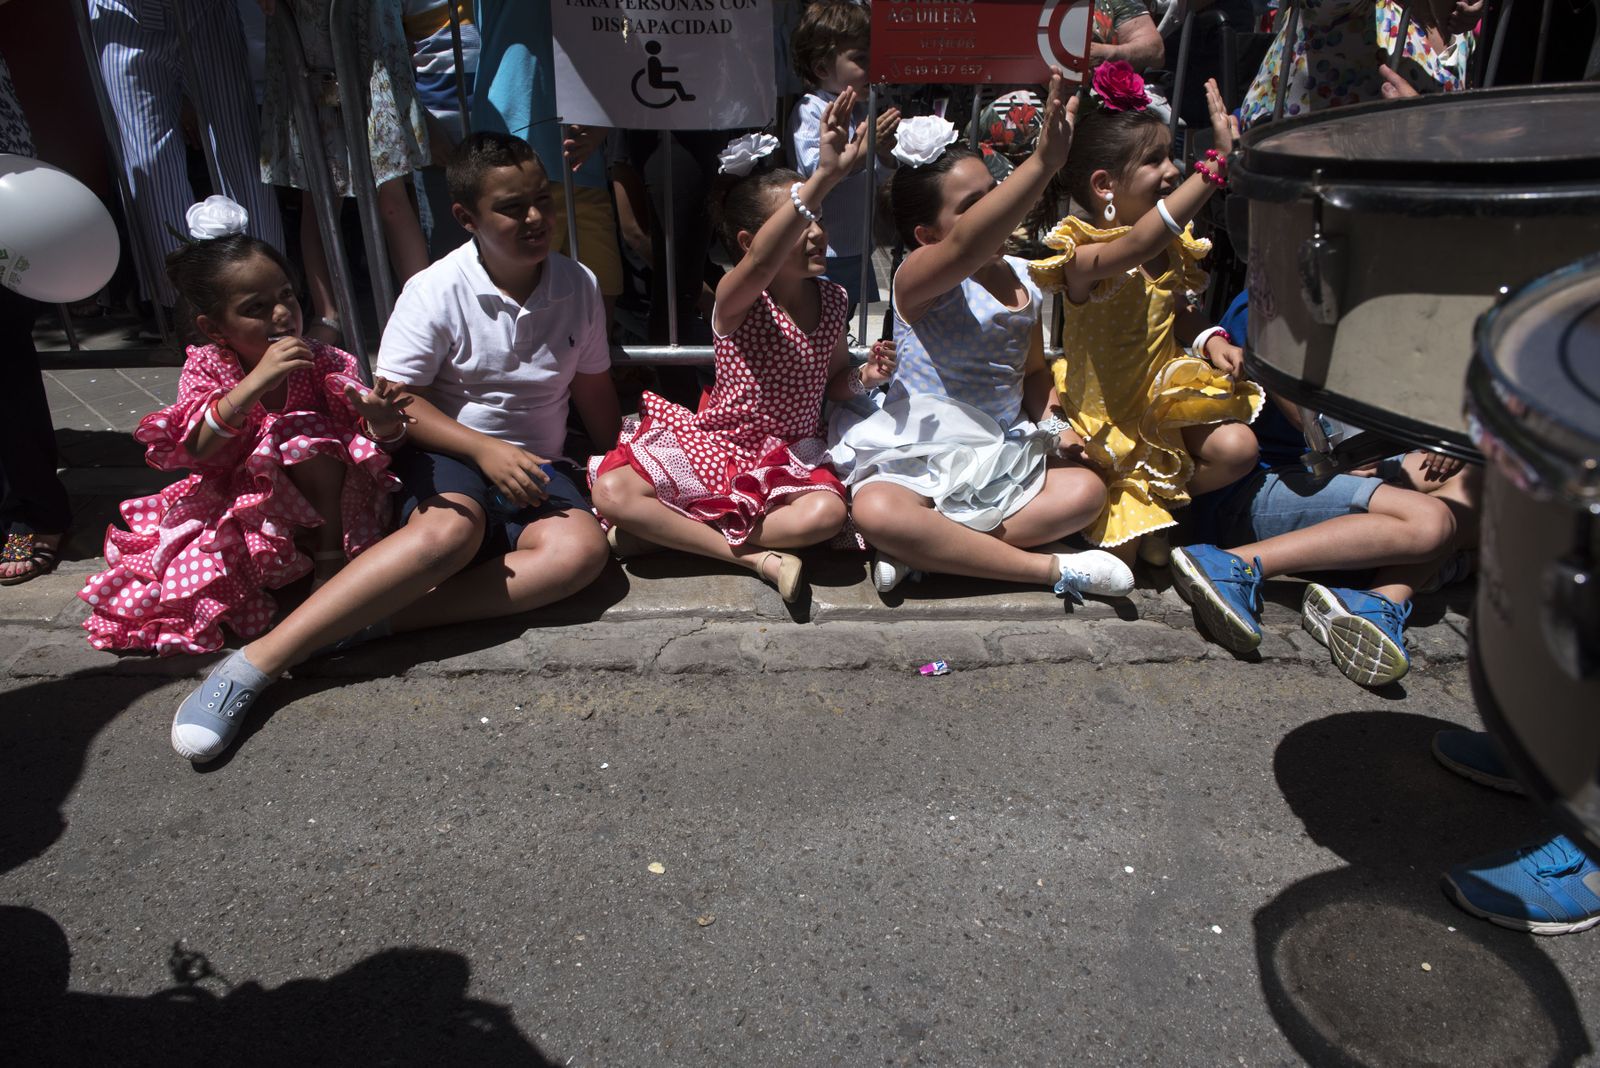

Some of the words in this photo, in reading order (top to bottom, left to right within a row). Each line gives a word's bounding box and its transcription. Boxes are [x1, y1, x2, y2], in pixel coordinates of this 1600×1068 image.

[614, 0, 715, 10] PERSONAS
[888, 7, 977, 23] AGUILERA
[591, 16, 733, 35] DISCAPACIDAD
